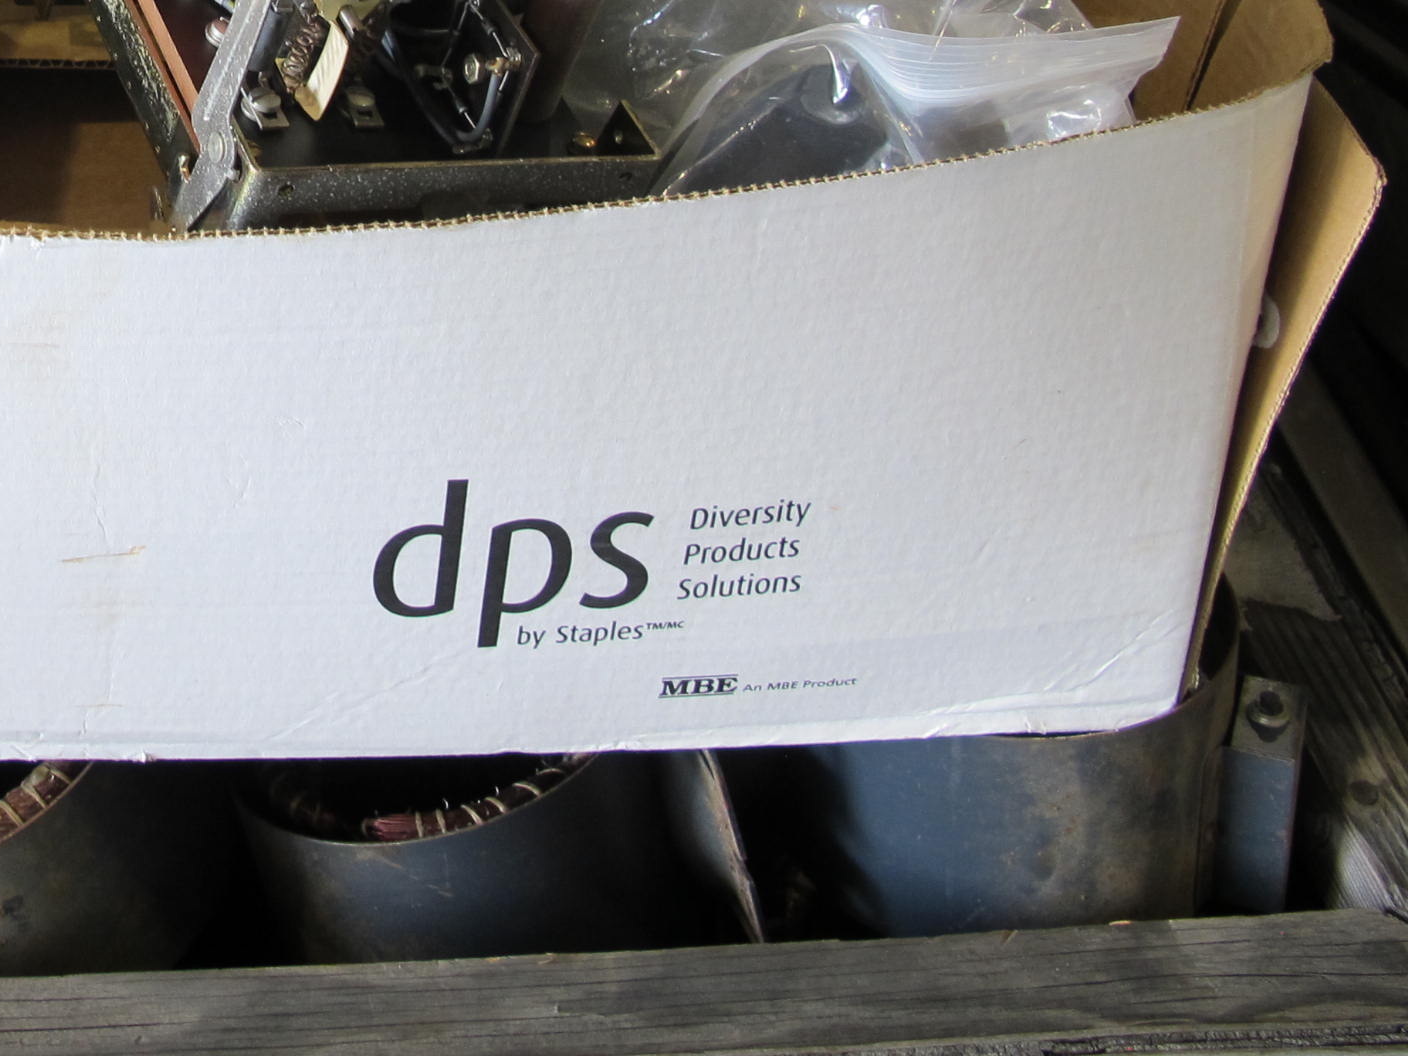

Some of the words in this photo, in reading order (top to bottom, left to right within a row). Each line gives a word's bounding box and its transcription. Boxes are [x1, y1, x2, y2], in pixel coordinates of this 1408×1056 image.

[689, 499, 812, 532] Diversity
[372, 479, 655, 648] dps
[682, 536, 801, 566] Products
[675, 570, 802, 601] Solutions
[516, 624, 547, 650] by
[660, 677, 738, 696] MBE
[742, 683, 762, 692] An
[767, 680, 799, 691] MBE
[803, 677, 857, 688] Product
